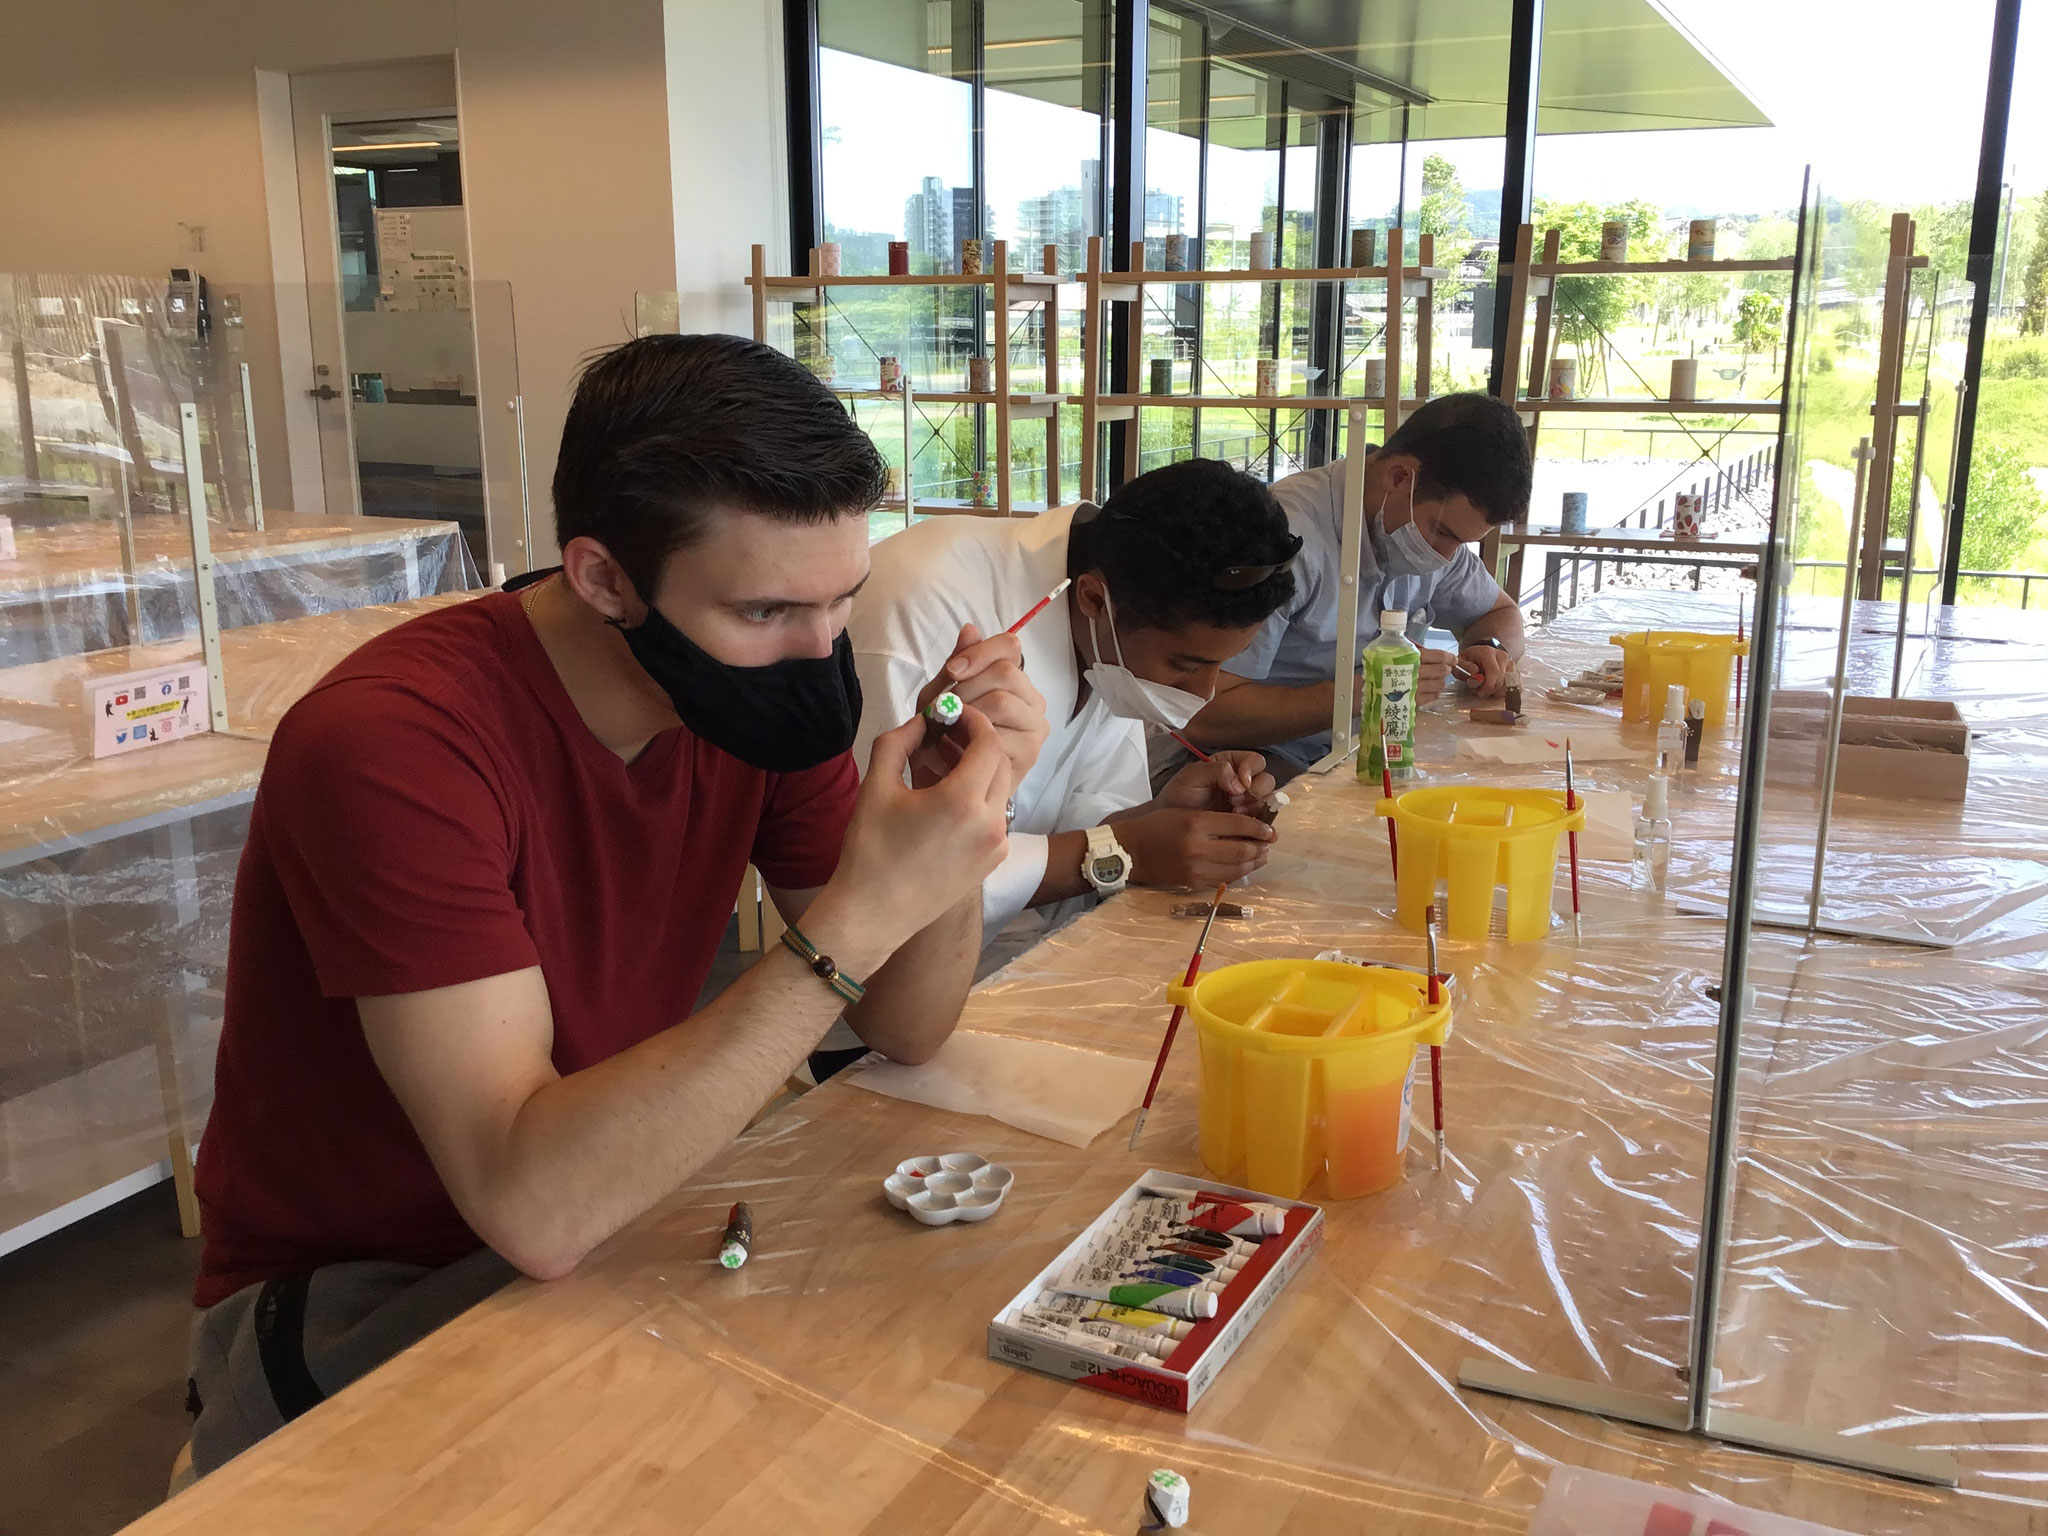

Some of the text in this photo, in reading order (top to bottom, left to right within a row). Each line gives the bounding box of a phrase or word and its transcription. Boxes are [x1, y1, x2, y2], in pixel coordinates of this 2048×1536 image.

[1391, 677, 1406, 688] 旨み
[1384, 703, 1402, 738] 綾鷹
[1087, 1361, 1102, 1376] 12
[1107, 1367, 1180, 1397] GOUACHE
